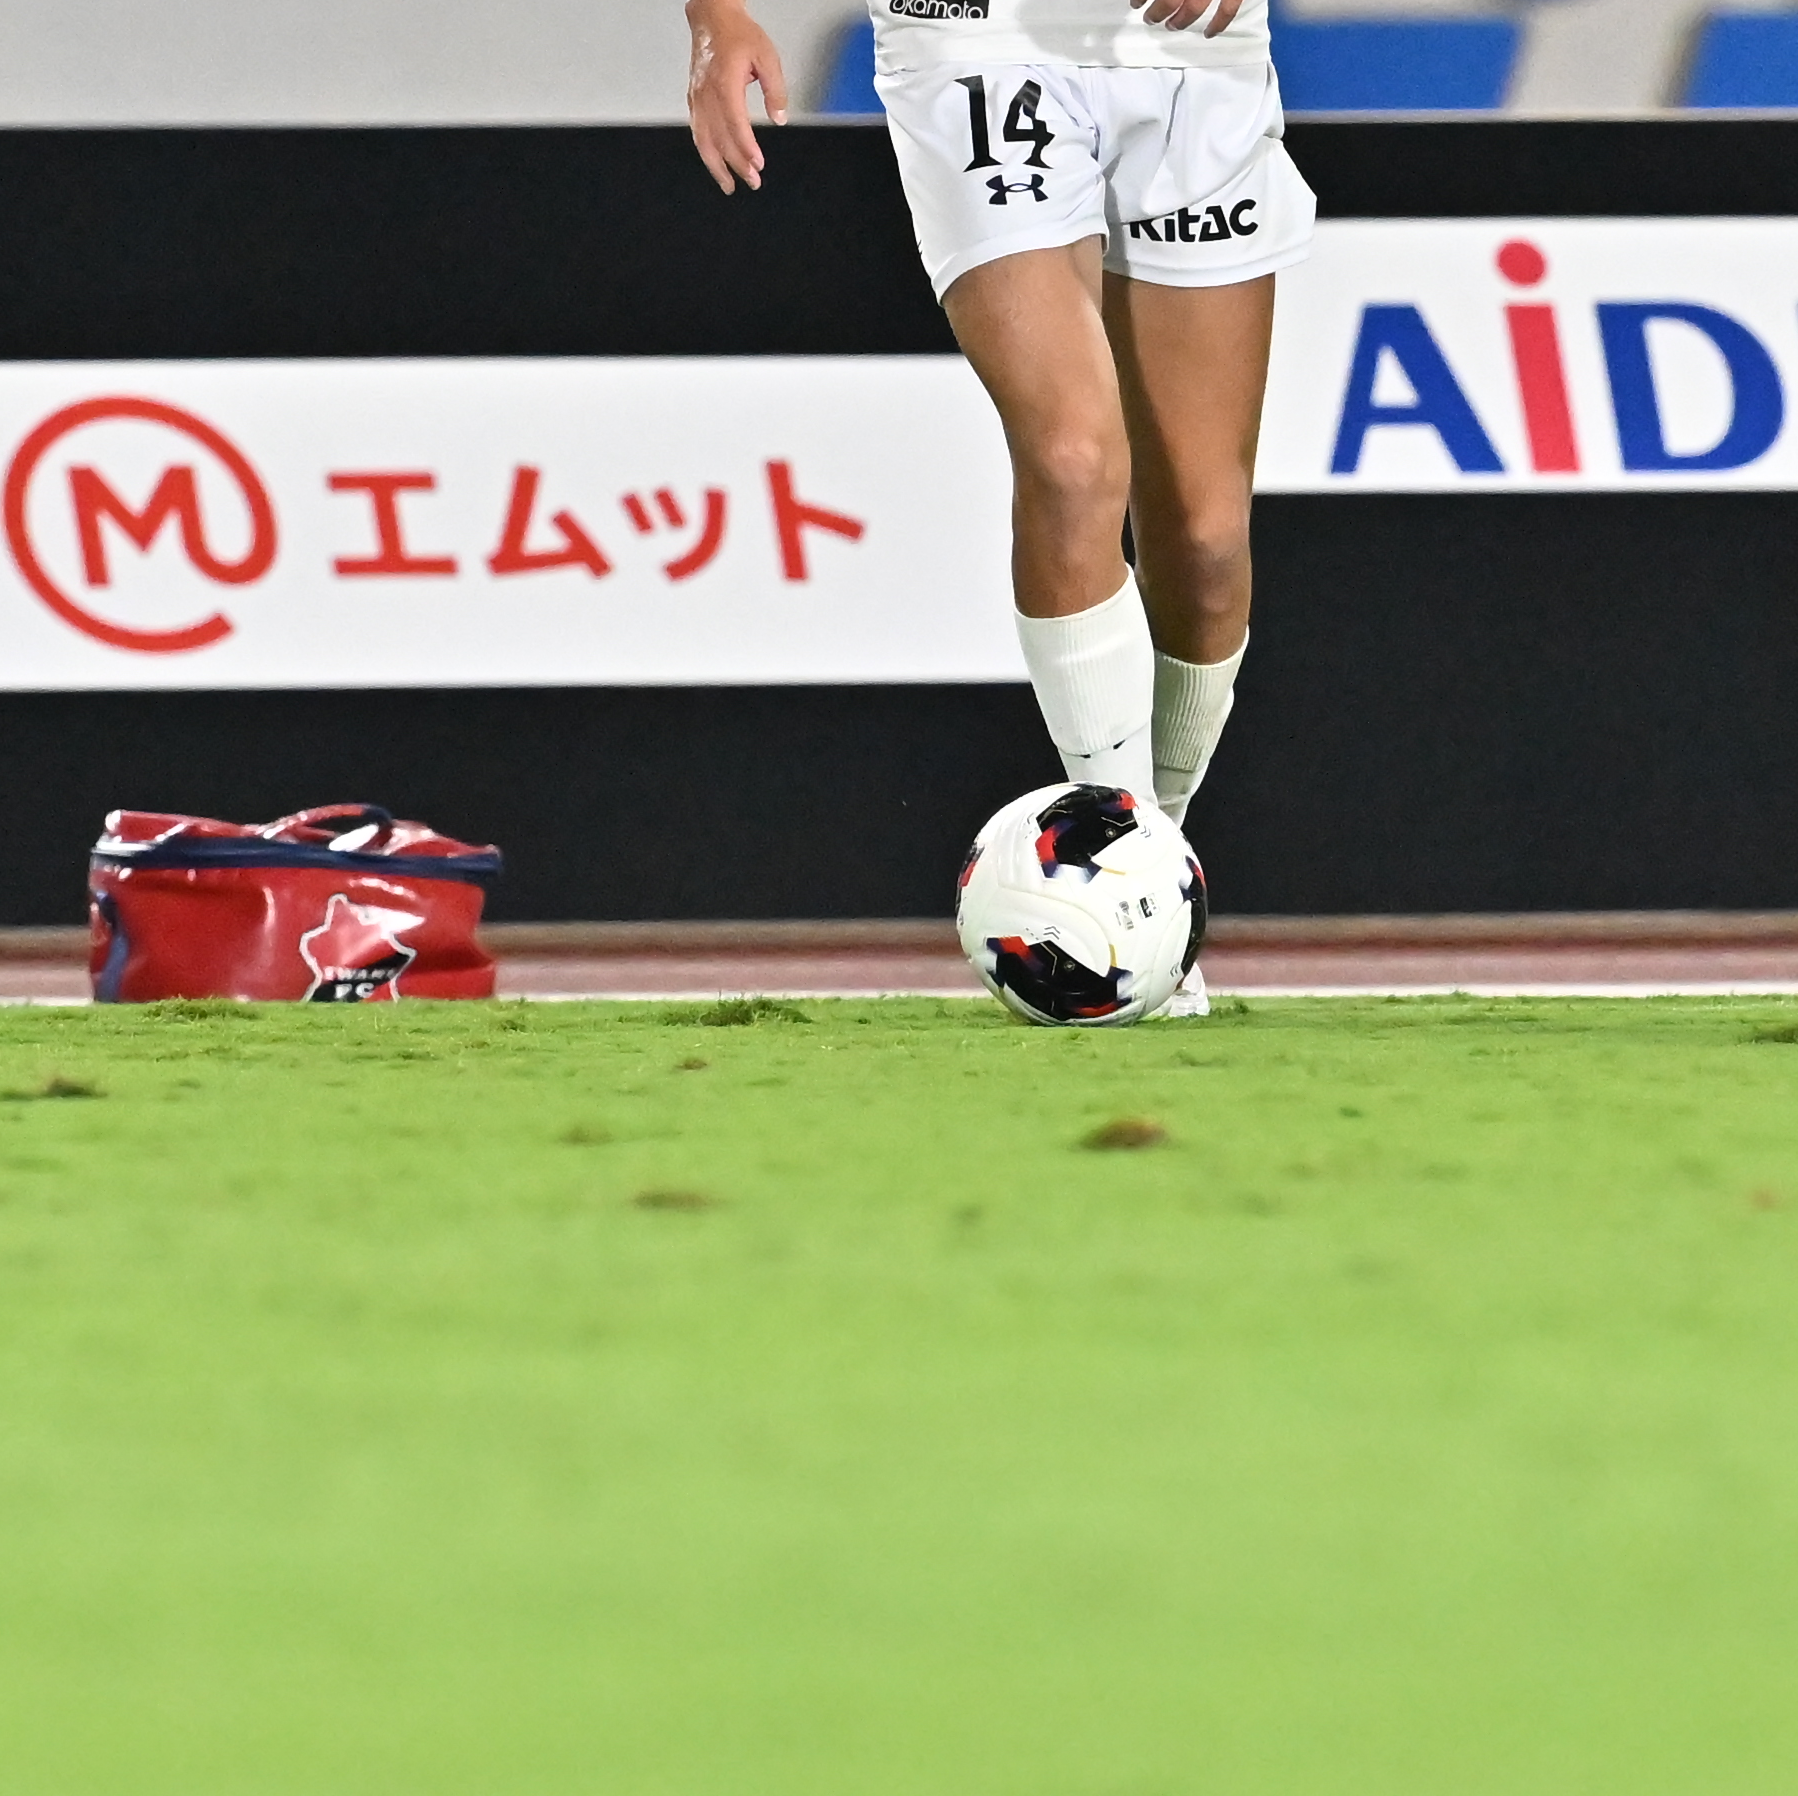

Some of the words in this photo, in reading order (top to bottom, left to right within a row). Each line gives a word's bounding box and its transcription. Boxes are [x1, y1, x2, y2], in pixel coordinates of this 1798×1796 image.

[953, 74, 1056, 173] 14
[325, 459, 867, 584] エムット
